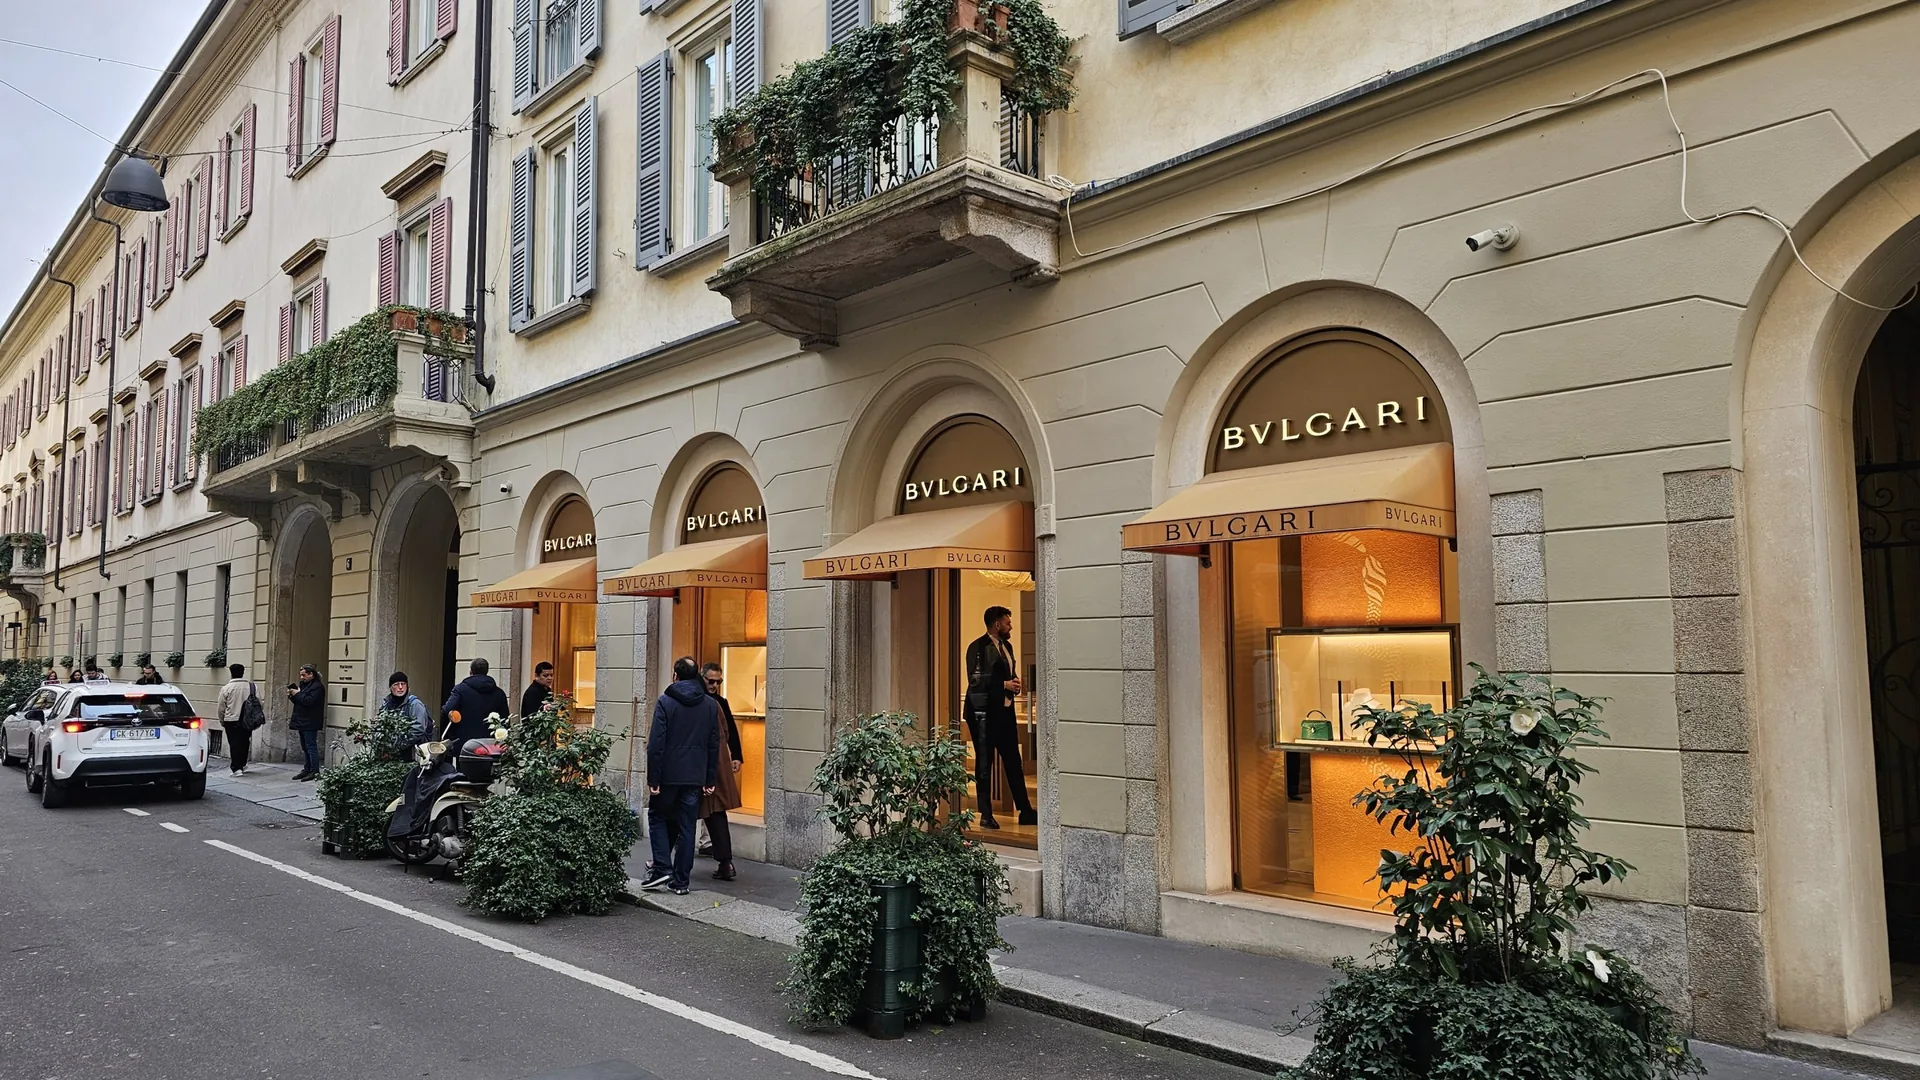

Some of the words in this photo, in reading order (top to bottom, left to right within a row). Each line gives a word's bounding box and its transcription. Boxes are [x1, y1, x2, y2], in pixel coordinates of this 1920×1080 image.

[1223, 396, 1428, 450] BVLGARI
[905, 467, 1022, 500] BVLGARI
[686, 505, 763, 531] BVLGARI
[1165, 510, 1315, 541] BVLGARI
[1385, 507, 1443, 528] BVLGARI
[826, 553, 908, 574] BVLGARI
[947, 553, 1006, 564] BVLGARI
[617, 574, 671, 591] BVLGARI
[697, 574, 754, 584] BVLGARI
[480, 591, 518, 603] BVLGARI
[537, 591, 588, 599] BVLGARI
